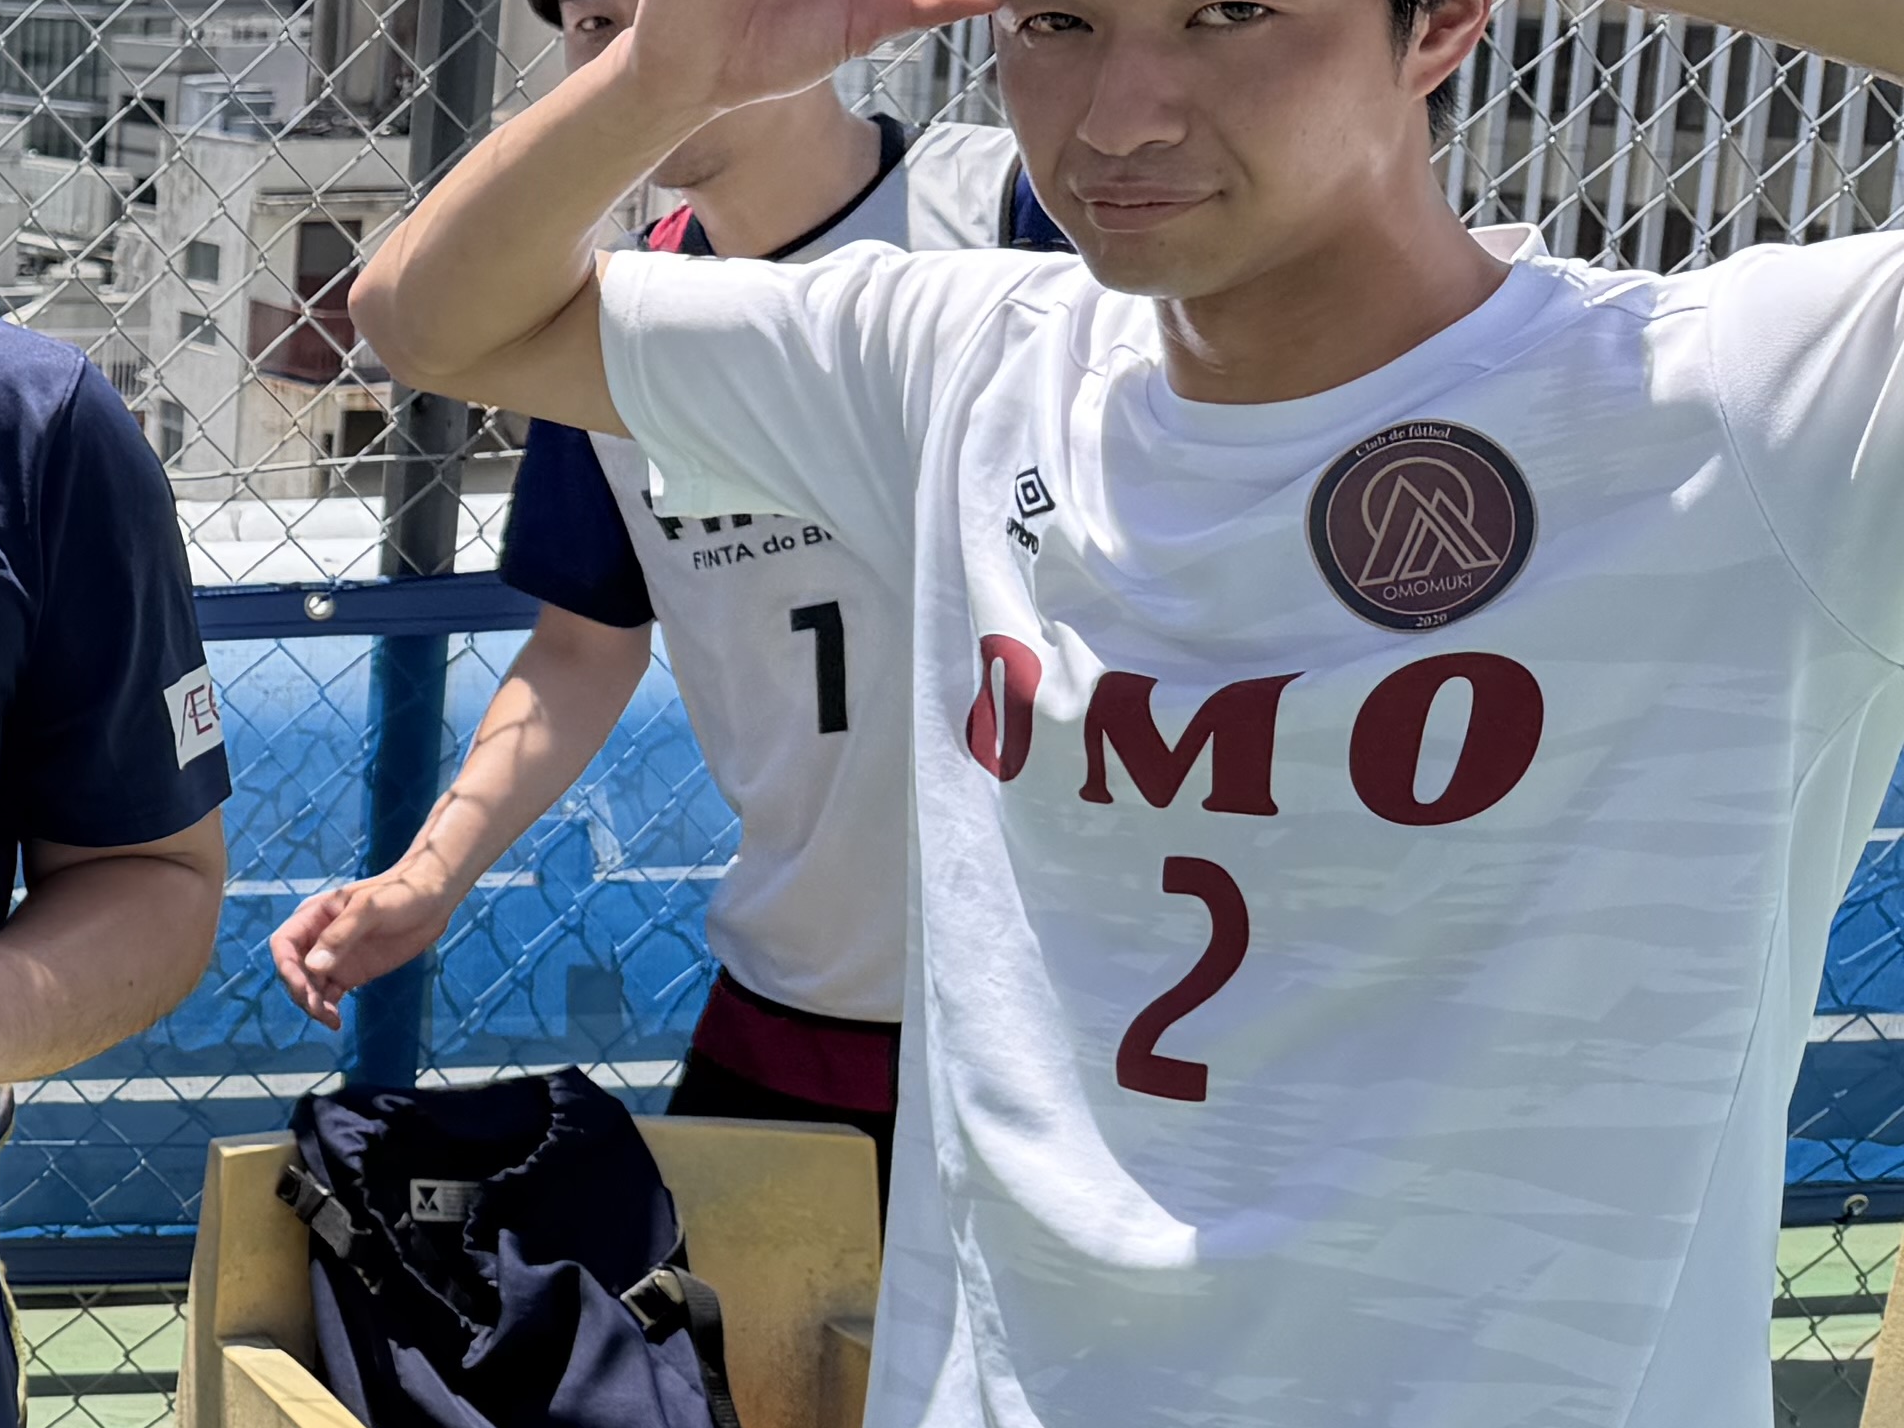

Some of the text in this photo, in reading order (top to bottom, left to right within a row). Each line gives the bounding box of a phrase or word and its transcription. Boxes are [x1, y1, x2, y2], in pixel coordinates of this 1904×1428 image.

[1388, 428, 1406, 442] de
[693, 543, 755, 570] FINTA
[763, 534, 795, 555] do
[1383, 573, 1473, 601] OMOMUKI
[1415, 613, 1448, 628] 2020
[790, 600, 849, 734] 1
[1115, 855, 1251, 1102] 2
